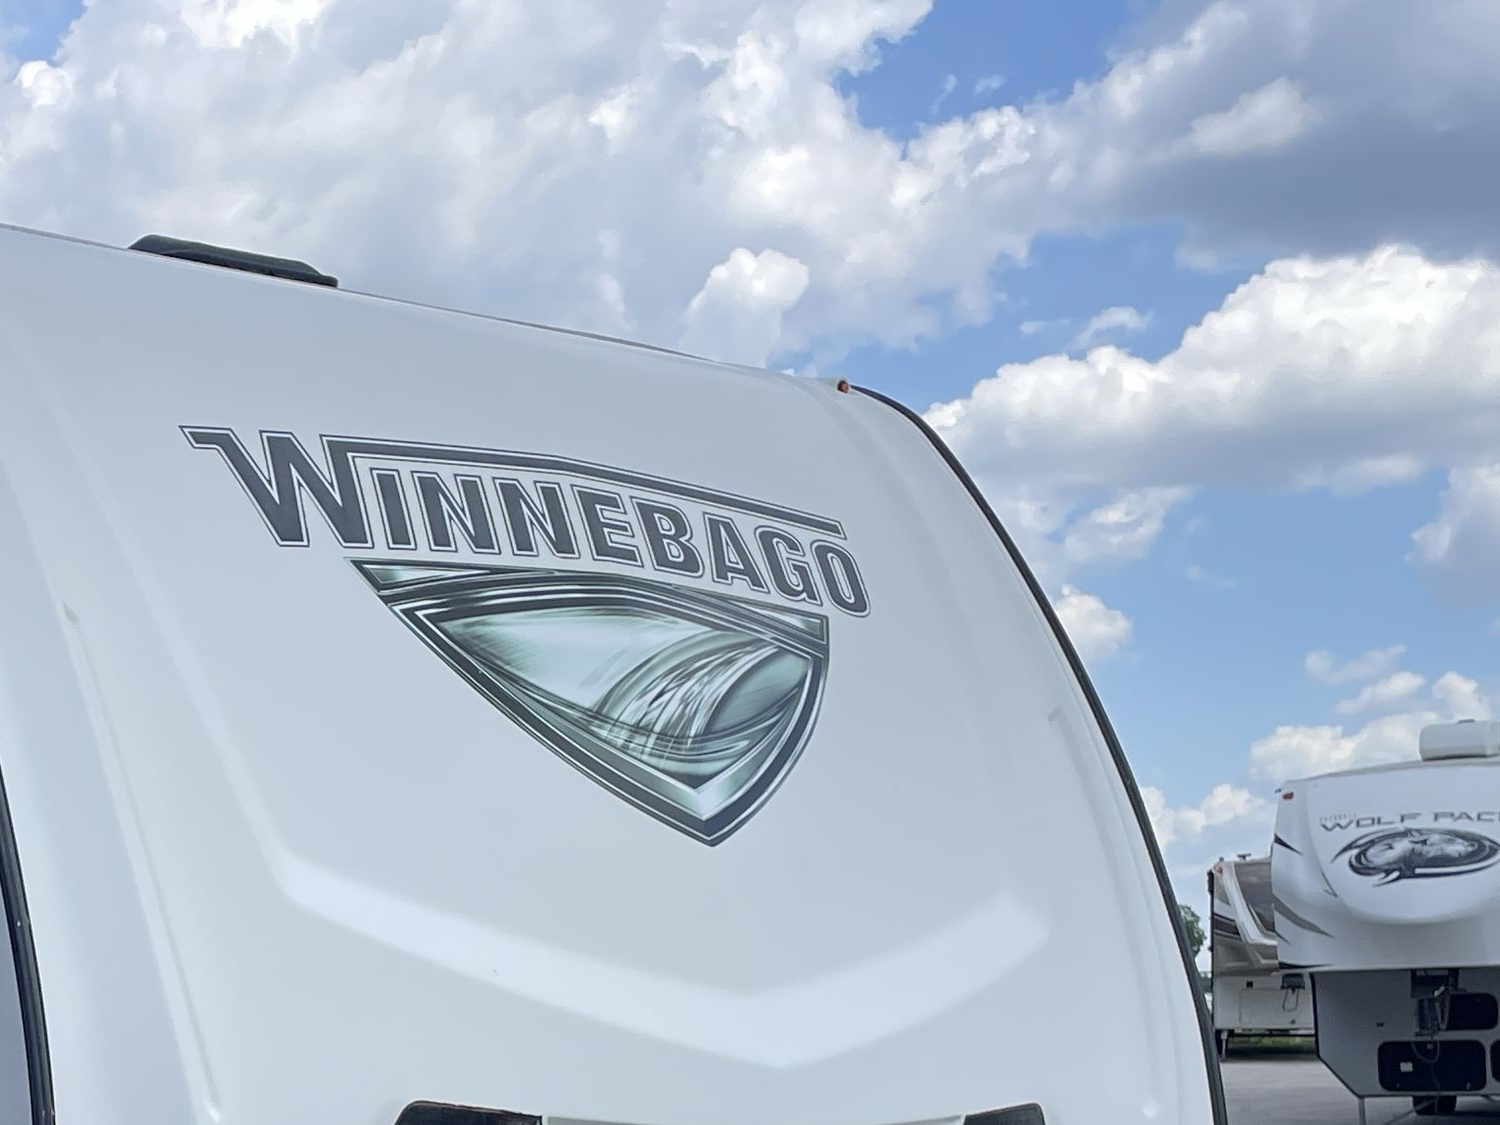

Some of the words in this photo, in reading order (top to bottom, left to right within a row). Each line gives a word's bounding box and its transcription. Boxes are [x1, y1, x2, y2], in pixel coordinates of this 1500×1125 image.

[179, 425, 872, 617] WINNEBAGO
[1320, 812, 1422, 832] WOLF
[1433, 810, 1500, 822] PAC
